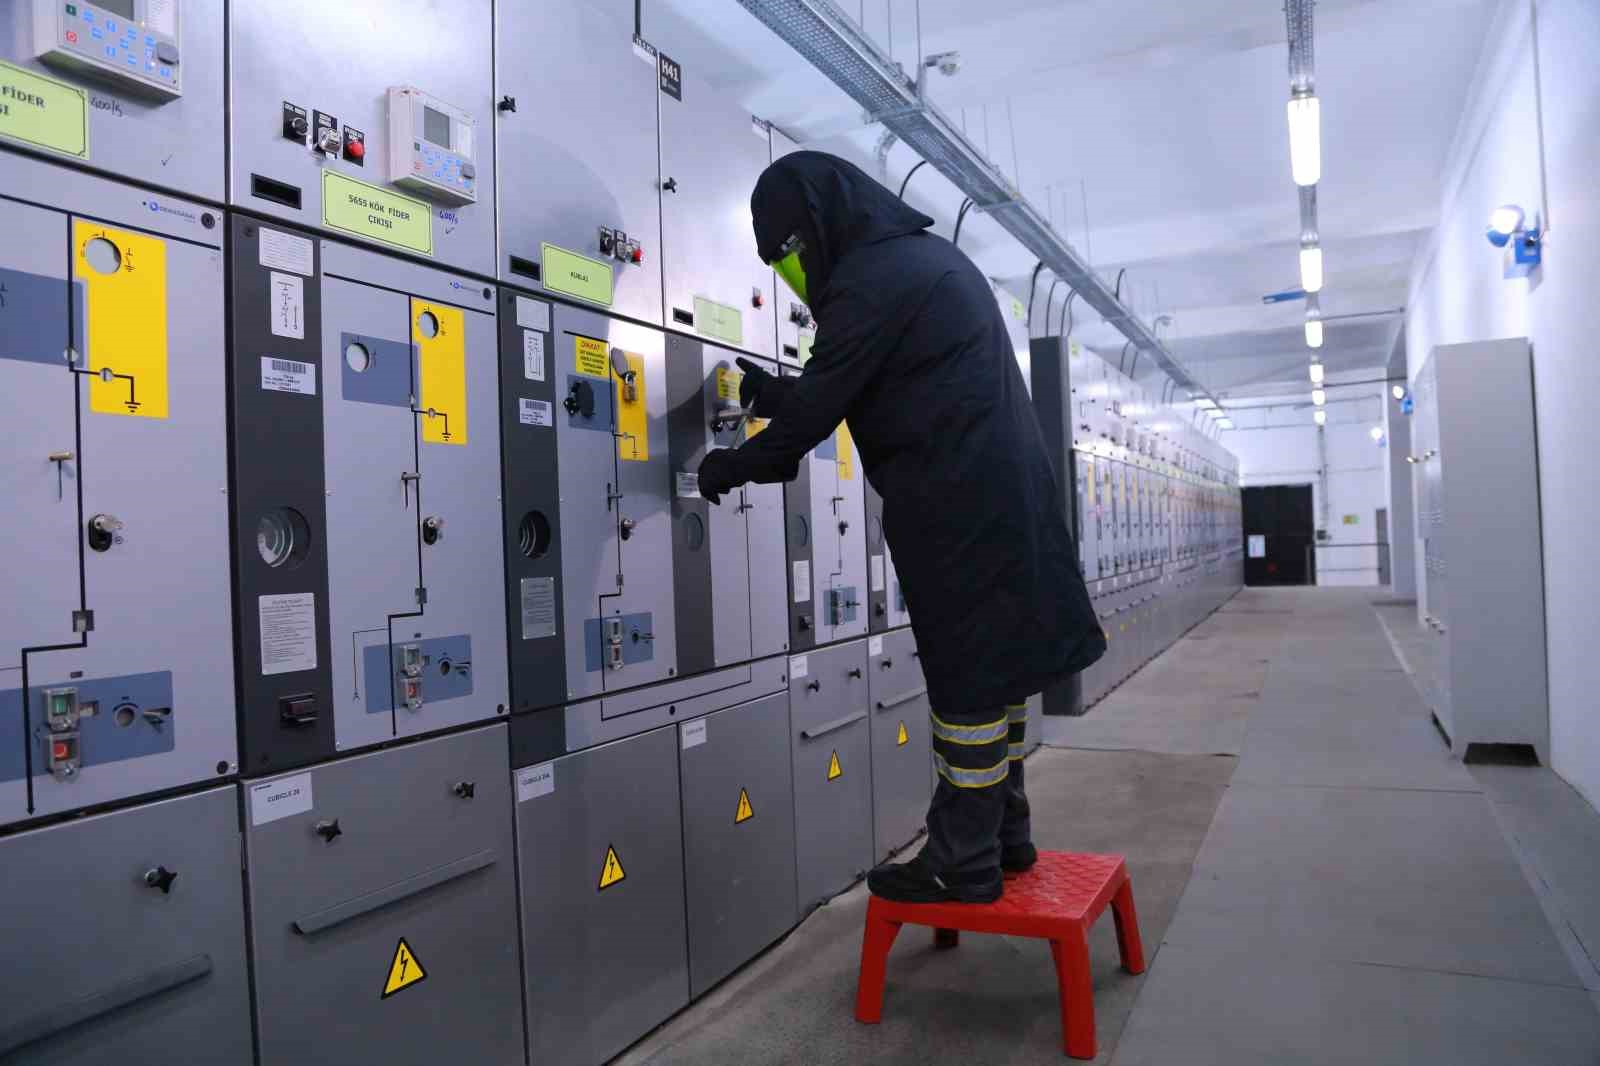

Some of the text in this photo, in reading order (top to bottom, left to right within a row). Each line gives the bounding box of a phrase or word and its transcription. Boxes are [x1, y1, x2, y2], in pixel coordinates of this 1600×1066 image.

[661, 59, 679, 82] H41
[1, 85, 46, 108] FİDER
[369, 200, 385, 214] KÖK
[388, 206, 410, 221] FİDER
